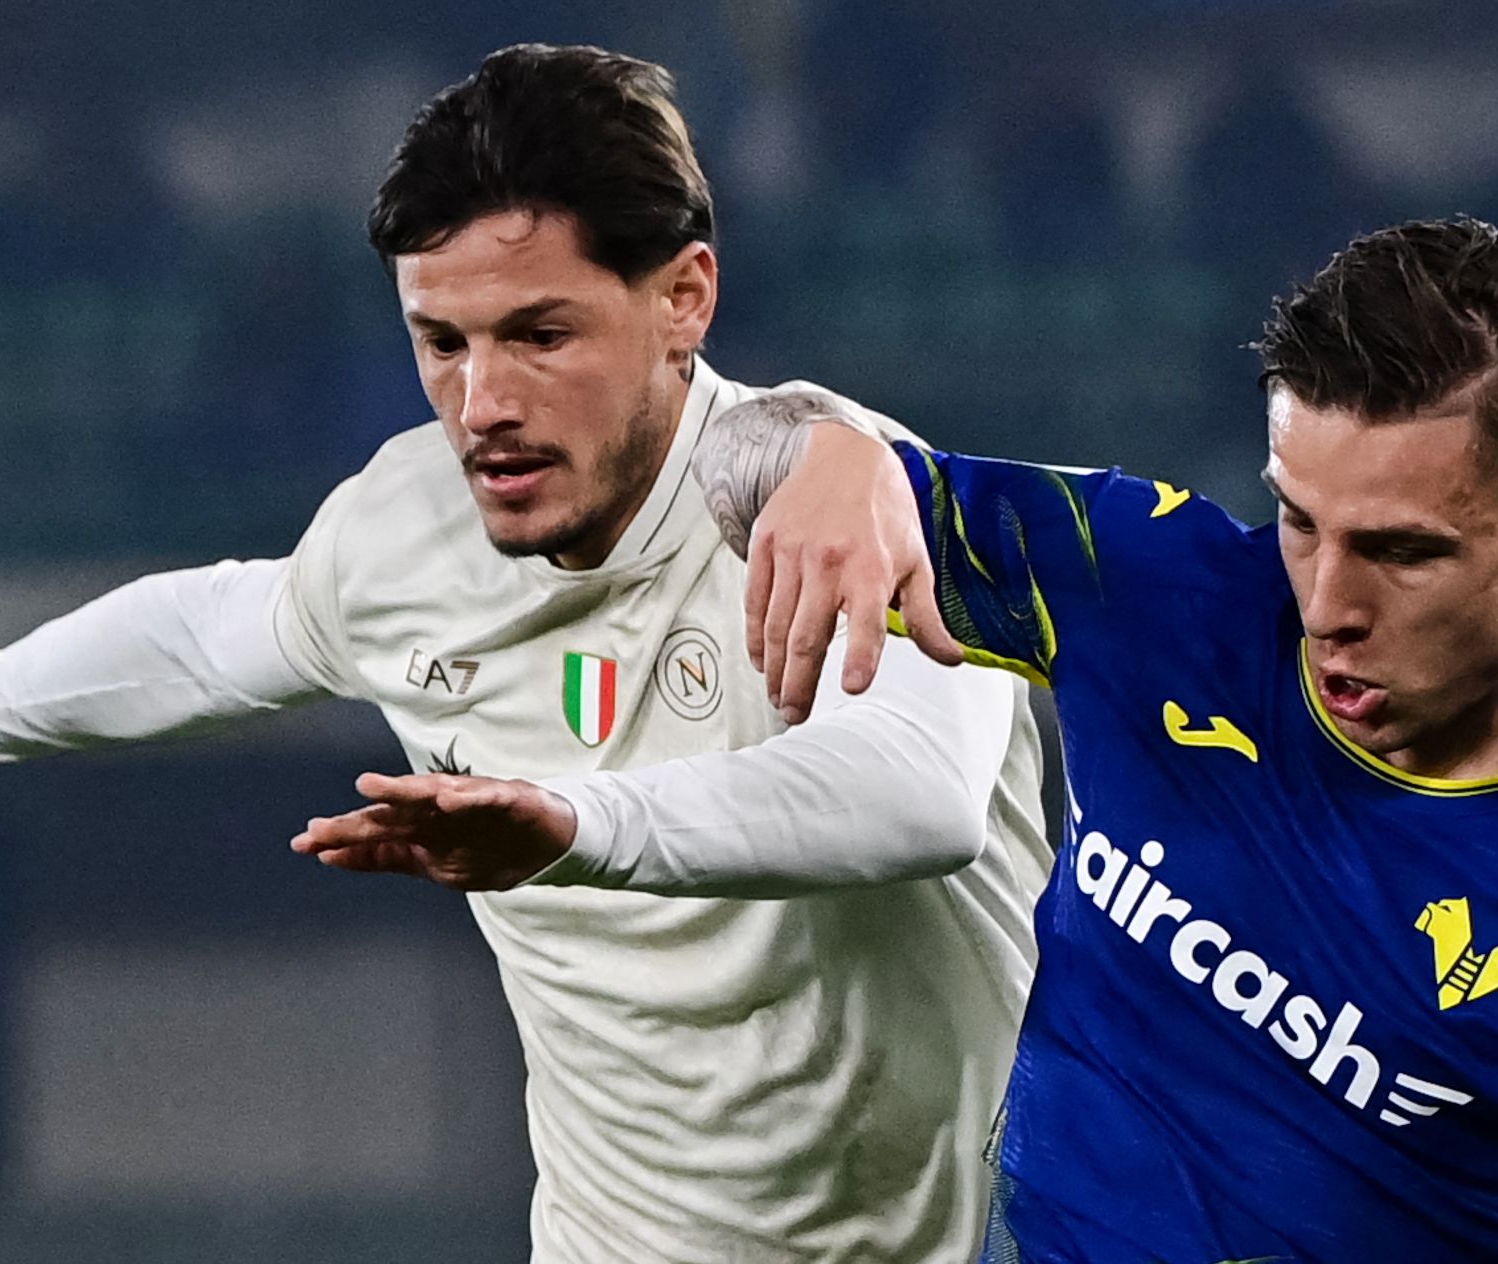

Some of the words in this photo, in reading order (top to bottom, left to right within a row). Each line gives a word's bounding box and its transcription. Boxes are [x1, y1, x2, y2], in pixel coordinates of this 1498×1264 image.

[406, 648, 480, 694] EA7
[675, 651, 709, 697] N
[1076, 831, 1381, 1109] aircash
